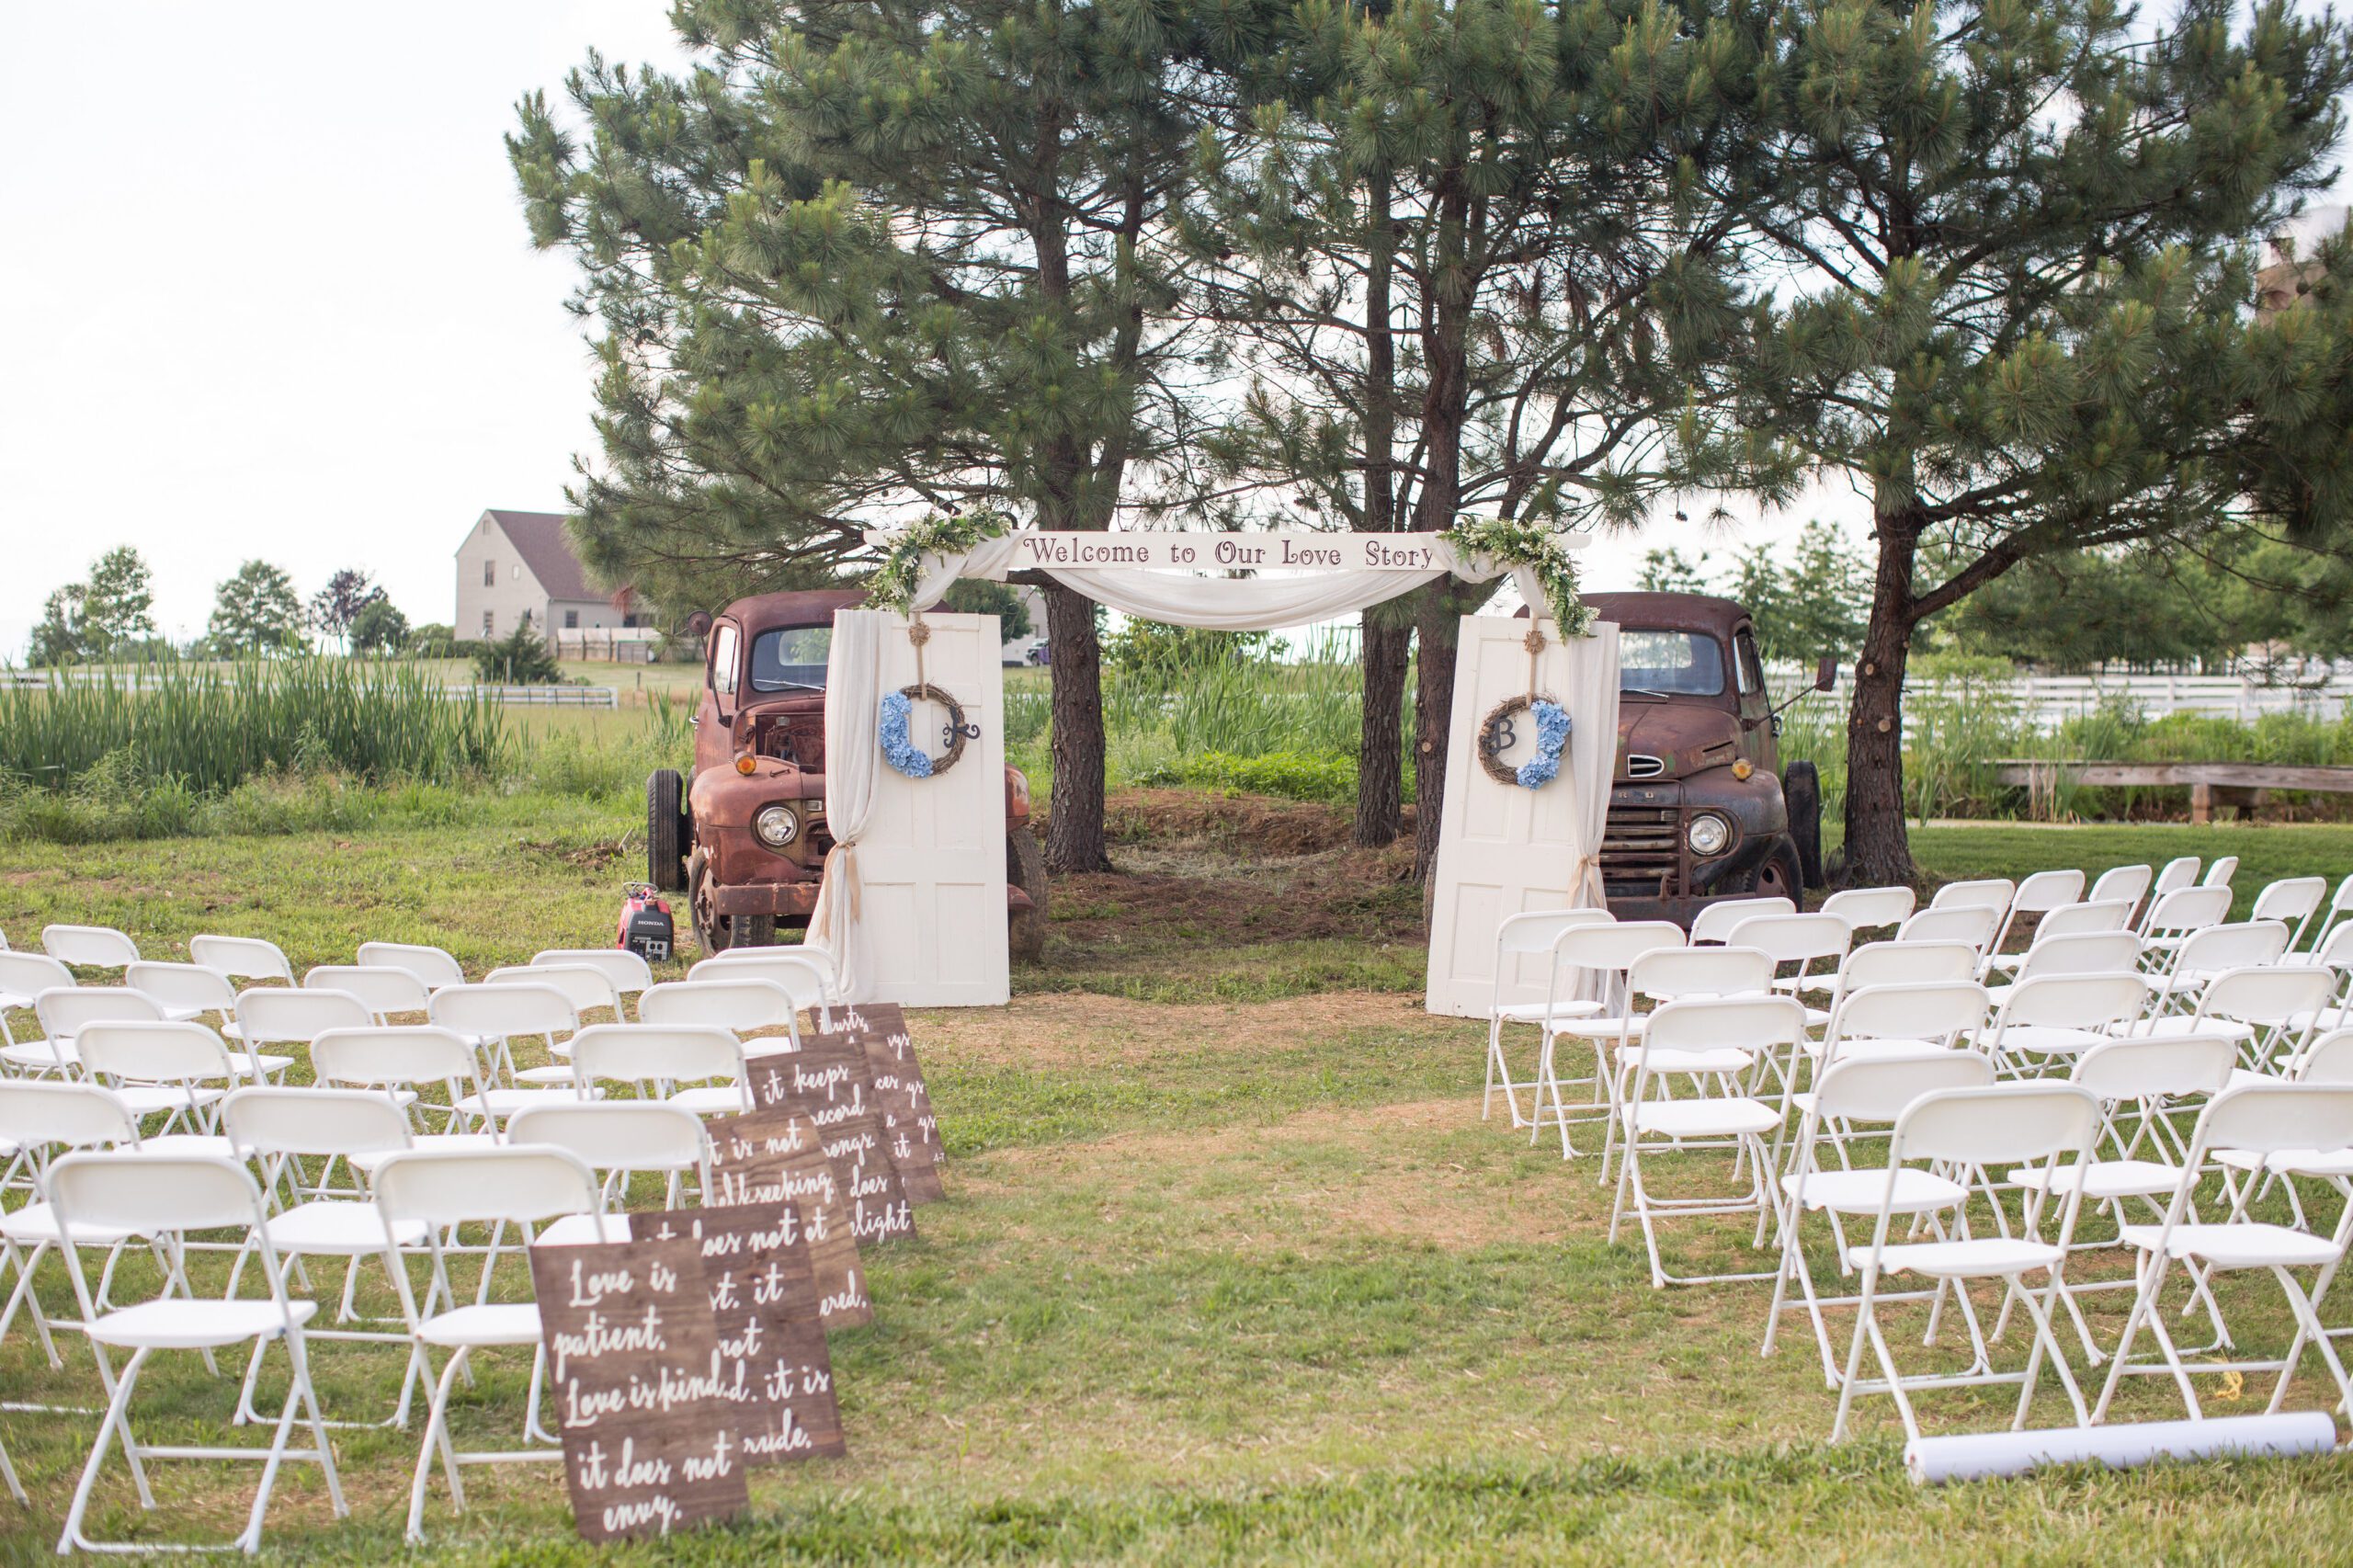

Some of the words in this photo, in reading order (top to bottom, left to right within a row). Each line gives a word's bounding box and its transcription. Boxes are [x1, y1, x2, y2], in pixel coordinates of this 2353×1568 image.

[1023, 537, 1149, 562] Welcome
[1170, 543, 1196, 563] to
[1214, 540, 1266, 563] Our
[1281, 540, 1341, 564] Love
[1366, 540, 1433, 570] Story
[762, 1069, 785, 1105] it
[793, 1063, 849, 1101] keeps
[730, 1137, 754, 1160] is
[766, 1118, 802, 1154] not
[893, 1131, 912, 1158] it
[849, 1164, 888, 1198] does
[748, 1207, 798, 1253] not
[569, 1258, 634, 1307] Love
[650, 1261, 677, 1293] is
[754, 1263, 785, 1305] it
[552, 1304, 666, 1384] patient.
[563, 1377, 627, 1427] Love
[629, 1375, 656, 1409] is
[656, 1347, 729, 1412] kind.
[763, 1358, 794, 1402] it
[801, 1365, 829, 1393] is
[744, 1407, 813, 1453] rude.
[577, 1440, 608, 1490] it
[614, 1436, 672, 1488] does
[683, 1429, 733, 1483] not
[603, 1494, 682, 1538] envy.
